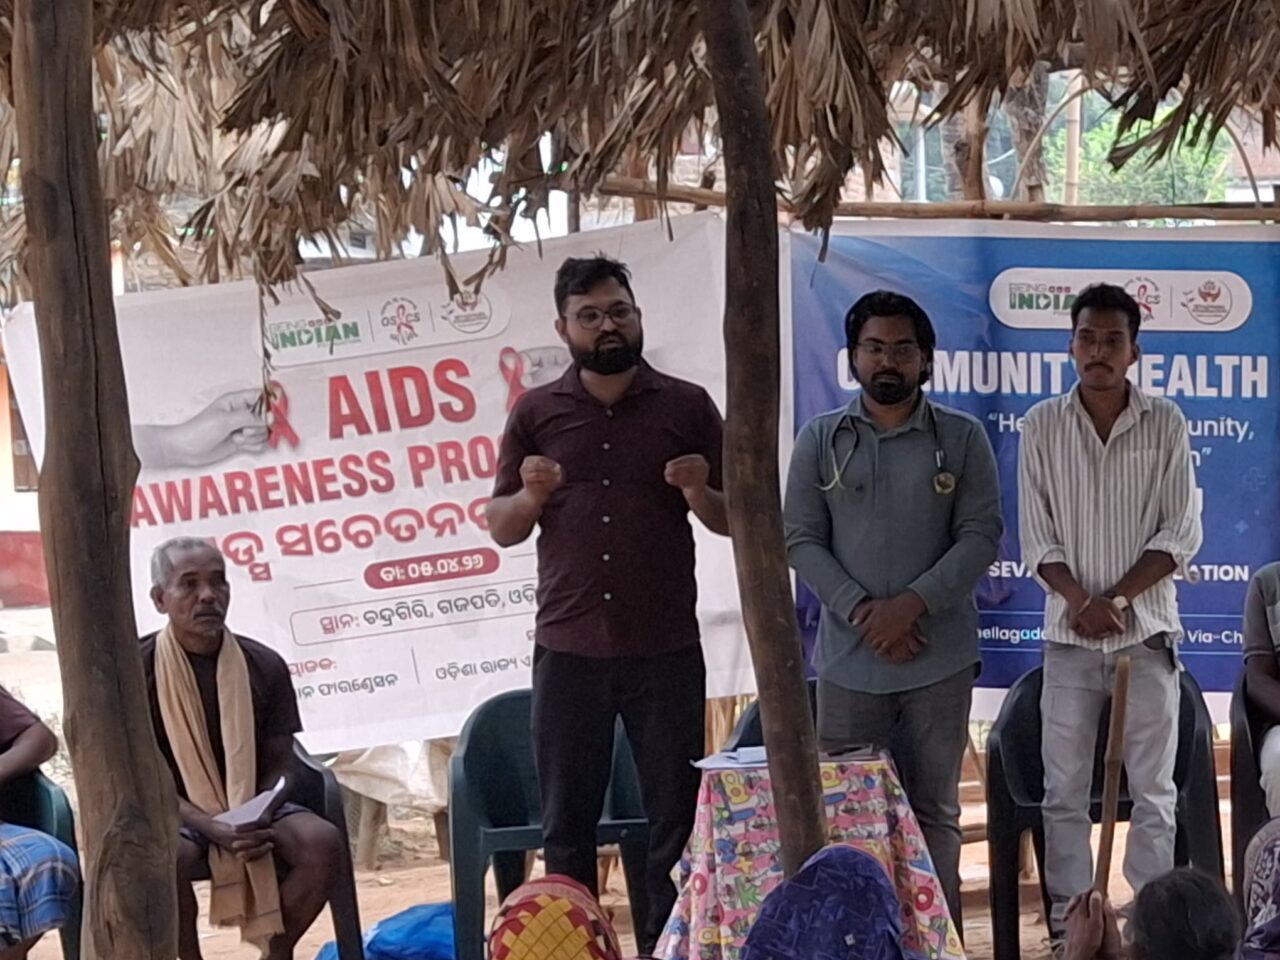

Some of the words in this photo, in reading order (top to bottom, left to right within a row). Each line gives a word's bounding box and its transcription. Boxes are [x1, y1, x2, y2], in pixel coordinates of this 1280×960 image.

[1009, 293, 1080, 310] INDIA
[329, 357, 476, 441] AIDS
[1187, 417, 1255, 443] unity,
[129, 450, 396, 529] AWARENESS
[406, 434, 504, 490] PRO
